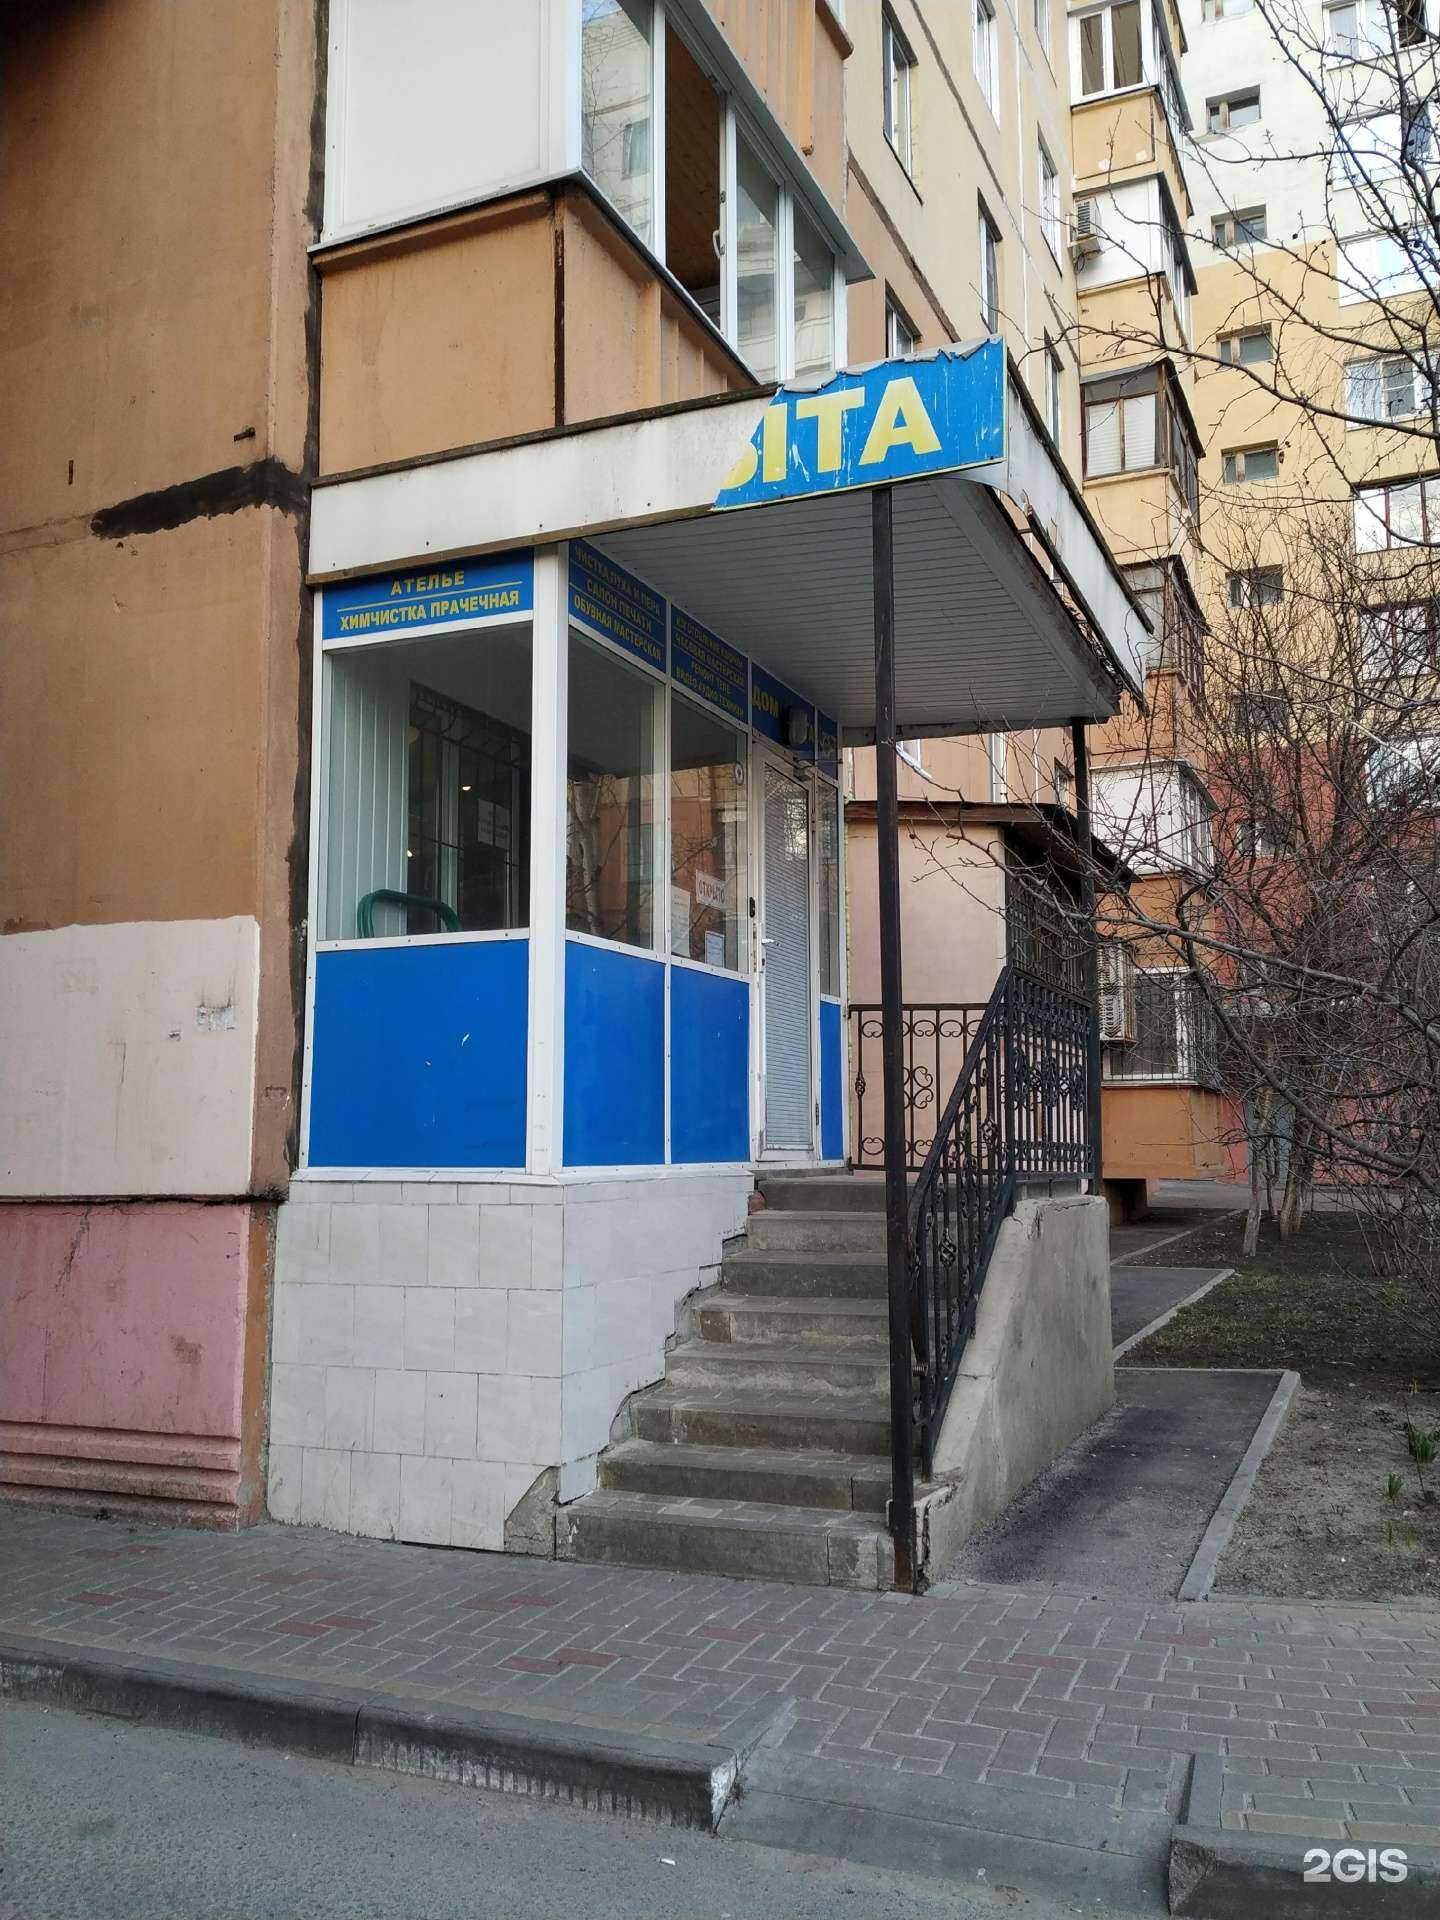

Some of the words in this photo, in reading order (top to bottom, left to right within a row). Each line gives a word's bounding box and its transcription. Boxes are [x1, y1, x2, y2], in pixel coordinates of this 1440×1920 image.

[390, 570, 465, 597] АТЕЛЬЕ
[339, 604, 428, 632] ХИМЧИСТКА
[430, 590, 520, 618] ПРАЧЕЧНАЯ
[586, 578, 618, 609] САЛОН
[619, 598, 652, 632] ПЕЧАТИ
[574, 594, 612, 629] ОБУВНАЯ
[613, 619, 662, 663] МАСТЕРСКАЯ
[752, 684, 779, 718] ДОМ
